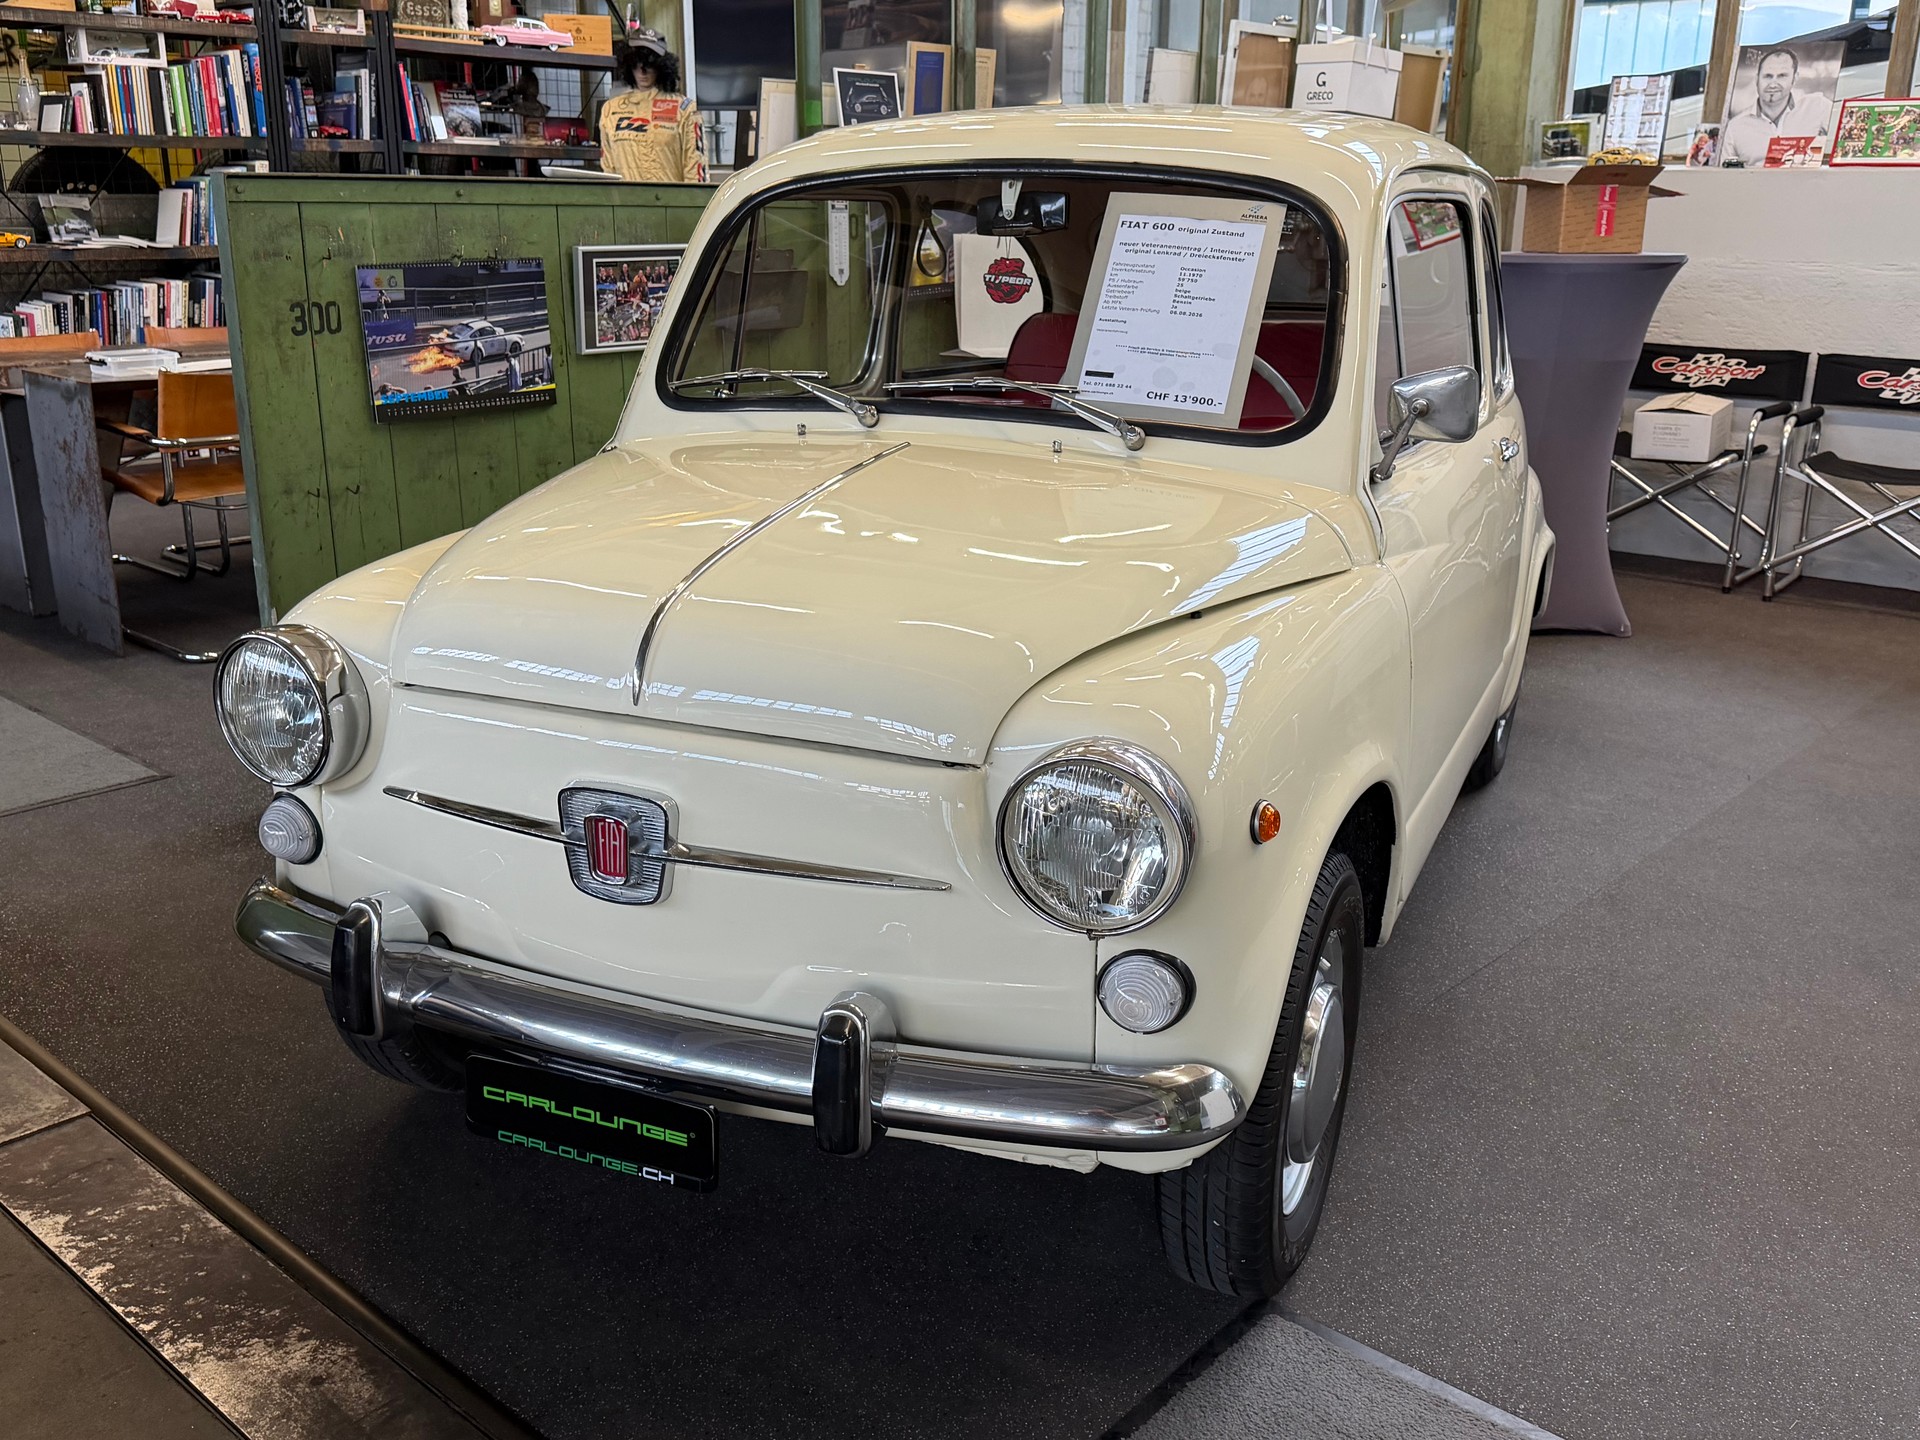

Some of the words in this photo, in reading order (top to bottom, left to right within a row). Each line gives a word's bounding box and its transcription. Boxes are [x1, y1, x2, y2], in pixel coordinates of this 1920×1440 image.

[1316, 72, 1326, 87] G
[1306, 92, 1334, 100] GRECO
[1120, 220, 1150, 230] FIAT
[1152, 222, 1175, 231] 600
[1178, 226, 1209, 234] original
[1211, 229, 1245, 238] Zustand
[1141, 242, 1202, 252] Veteraneneintrag
[1210, 247, 1242, 256] Interieur
[1190, 252, 1246, 262] Dreiecksfenster
[289, 301, 342, 336] 300
[1652, 356, 1766, 381] Carsport
[381, 390, 449, 404] SEPTEMBER
[1146, 391, 1170, 401] CHF
[1173, 394, 1222, 407] 13'900.-
[598, 822, 626, 874] FIAT
[498, 1130, 674, 1186] CARLOUNGE.CH
